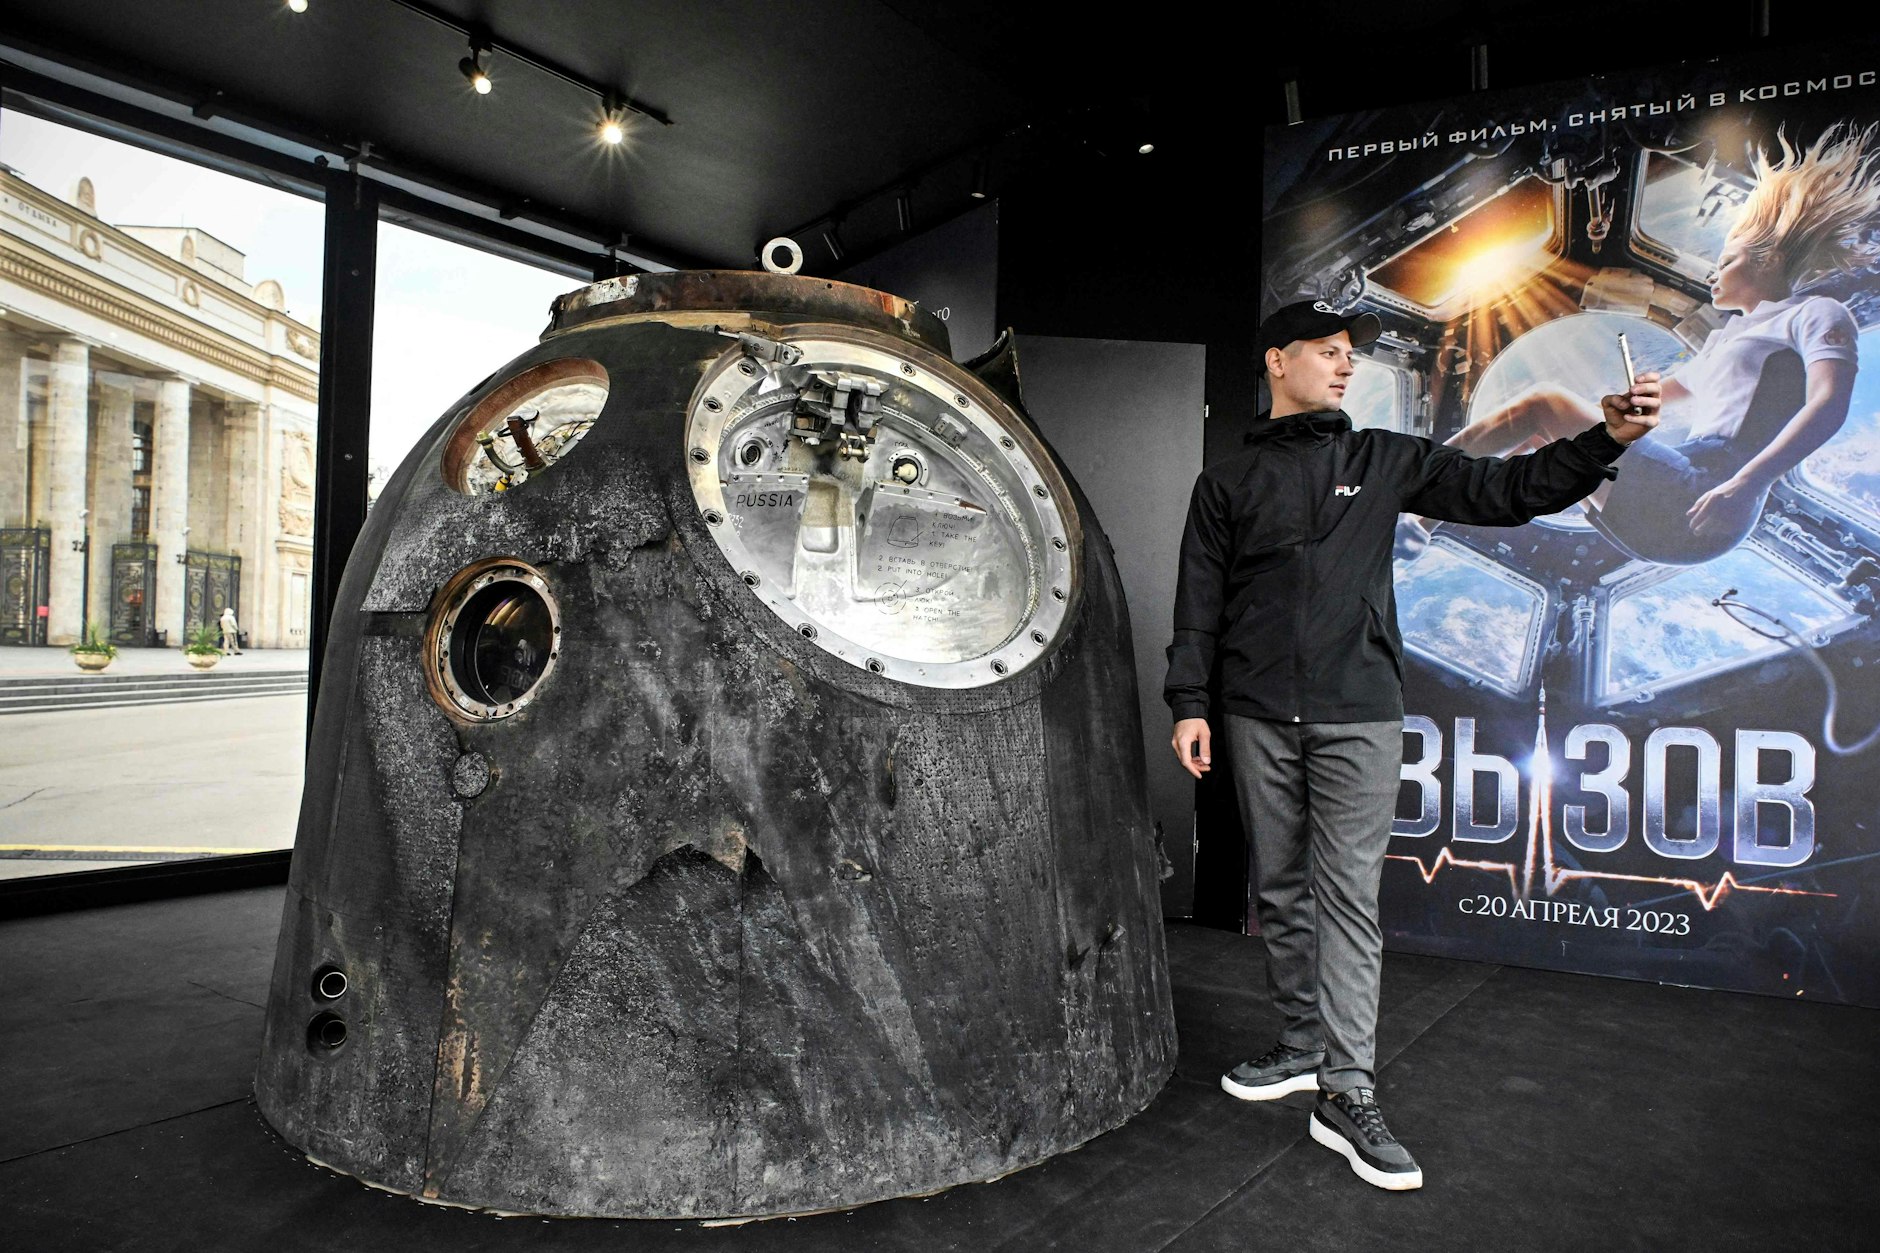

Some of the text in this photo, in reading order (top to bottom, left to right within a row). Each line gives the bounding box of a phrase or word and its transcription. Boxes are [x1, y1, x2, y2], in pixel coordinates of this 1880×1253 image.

[1328, 71, 1876, 162] ПЕРВЫЙ ФИЛЬМ, СНЯТЫЙ В КОСМОС
[941, 531, 959, 540] TAKE
[964, 534, 977, 543] THE
[929, 541, 945, 549] KEY!
[889, 556, 916, 565] ВСТАВЬ
[905, 568, 922, 576] INTO
[924, 607, 943, 615] OPEN
[947, 609, 961, 617] THE
[1389, 714, 1816, 867] ВЫЗОВ
[1509, 898, 1620, 929] АПРЕЛЯ
[1626, 909, 1691, 936] 2023
